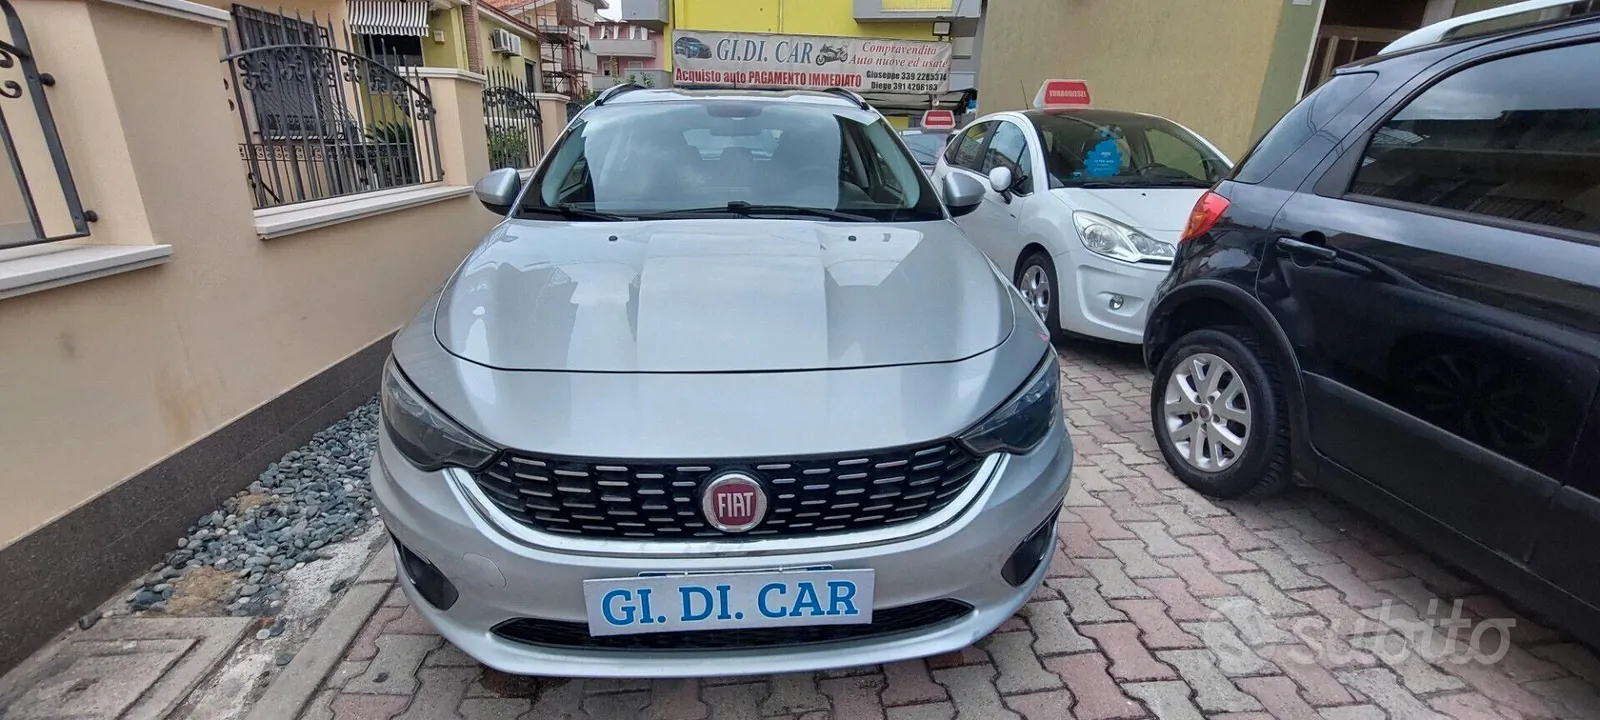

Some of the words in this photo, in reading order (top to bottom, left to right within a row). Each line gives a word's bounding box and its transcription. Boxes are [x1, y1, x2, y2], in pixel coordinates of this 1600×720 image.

[775, 40, 813, 64] CAR
[862, 41, 937, 56] Compravendita
[849, 54, 873, 65] Auto
[875, 58, 904, 67] nuove
[907, 57, 920, 68] ed
[922, 59, 948, 69] usate
[675, 68, 721, 83] Acquisto
[723, 71, 747, 84] auto
[748, 71, 807, 86] PAGAMENTO
[808, 72, 862, 88] IMMEDIATO
[866, 70, 900, 81] Giuseppe
[901, 72, 916, 81] 339
[871, 81, 892, 90] Diego
[893, 82, 906, 90] 391
[717, 492, 754, 518] FIAT
[601, 587, 667, 627] GI.
[678, 585, 744, 622] DI.
[756, 580, 859, 619] CAR
